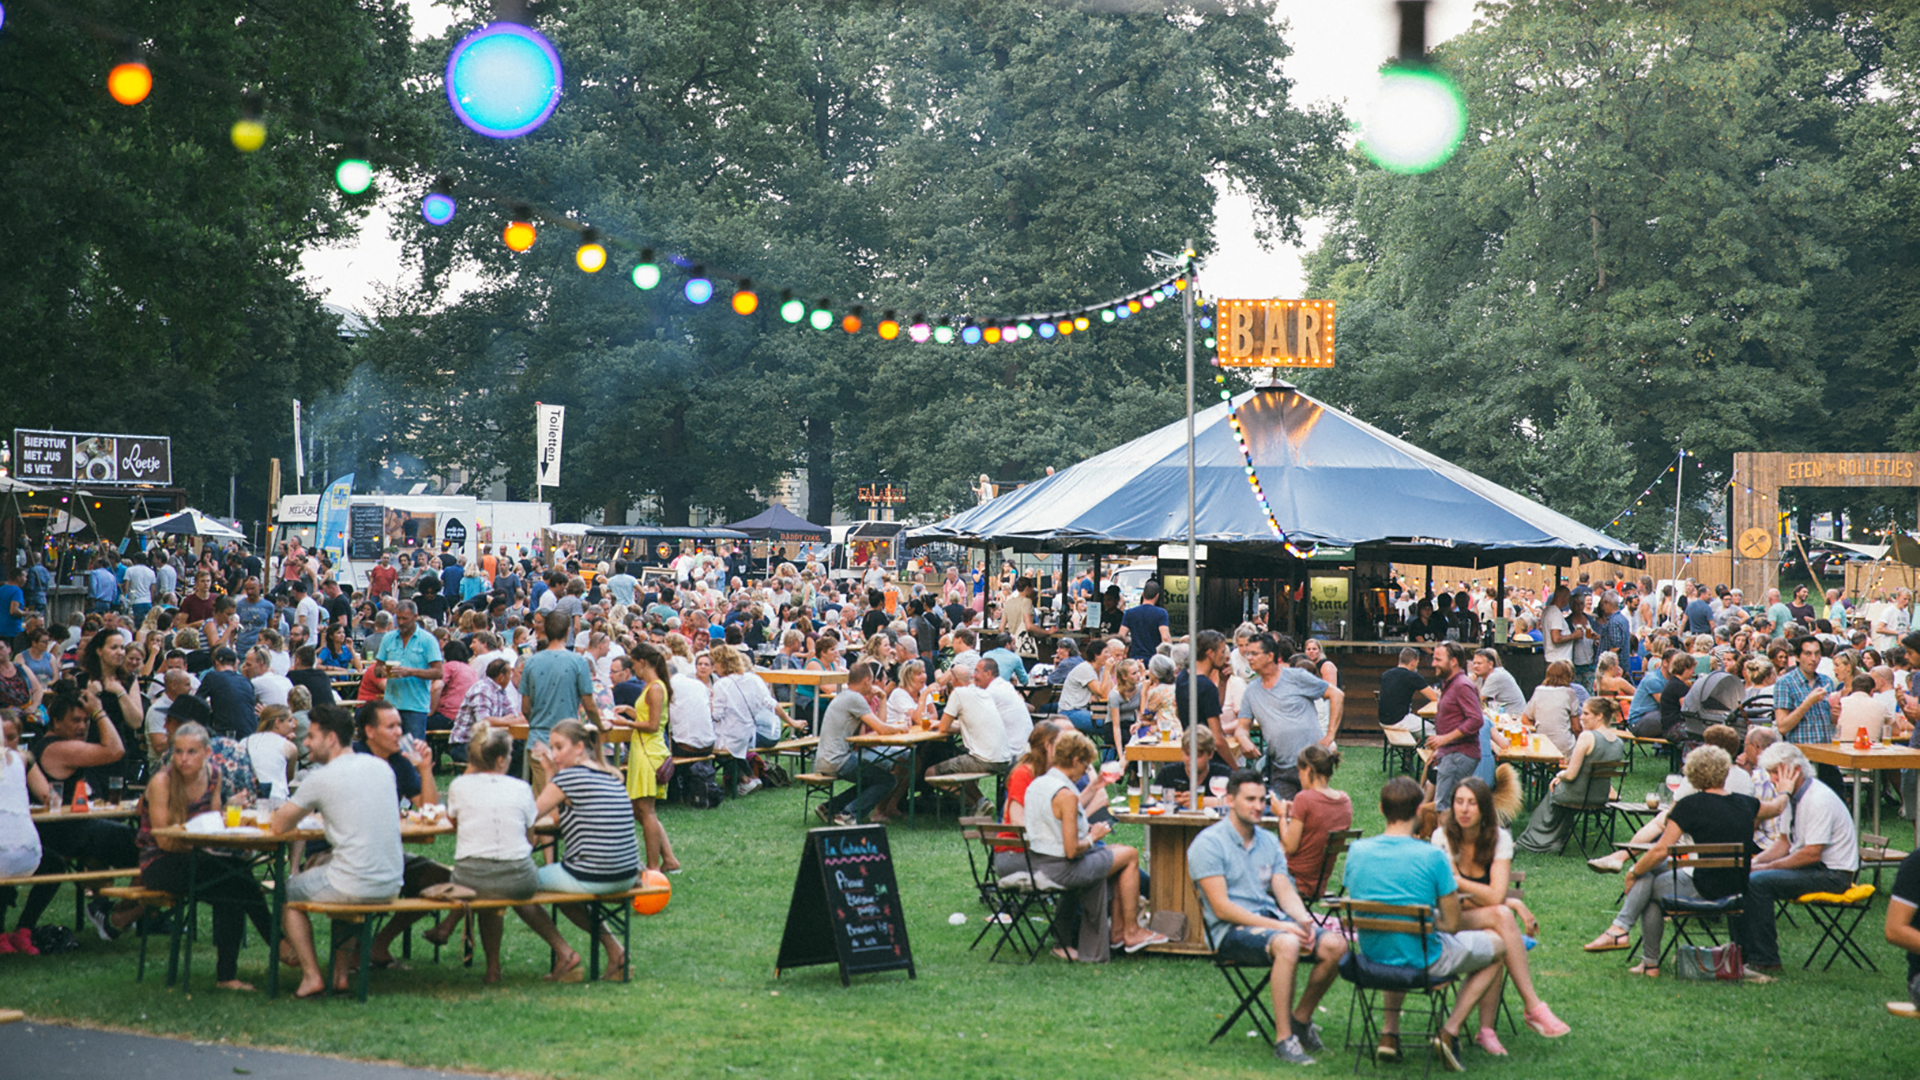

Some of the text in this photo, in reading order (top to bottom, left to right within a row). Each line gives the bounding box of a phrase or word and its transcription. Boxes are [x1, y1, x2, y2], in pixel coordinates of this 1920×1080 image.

[1231, 306, 1321, 359] BAR
[24, 436, 67, 449] BIEFSTUK
[548, 409, 562, 461] Toiletten
[24, 450, 61, 462] MET JUS
[122, 443, 160, 478] Loetje
[24, 463, 53, 474] IS VET.
[1788, 461, 1822, 479] ETEN
[1838, 459, 1914, 479] ROLLETJES
[858, 487, 906, 503] FALAFEL
[780, 533, 821, 542] DADDY COOL
